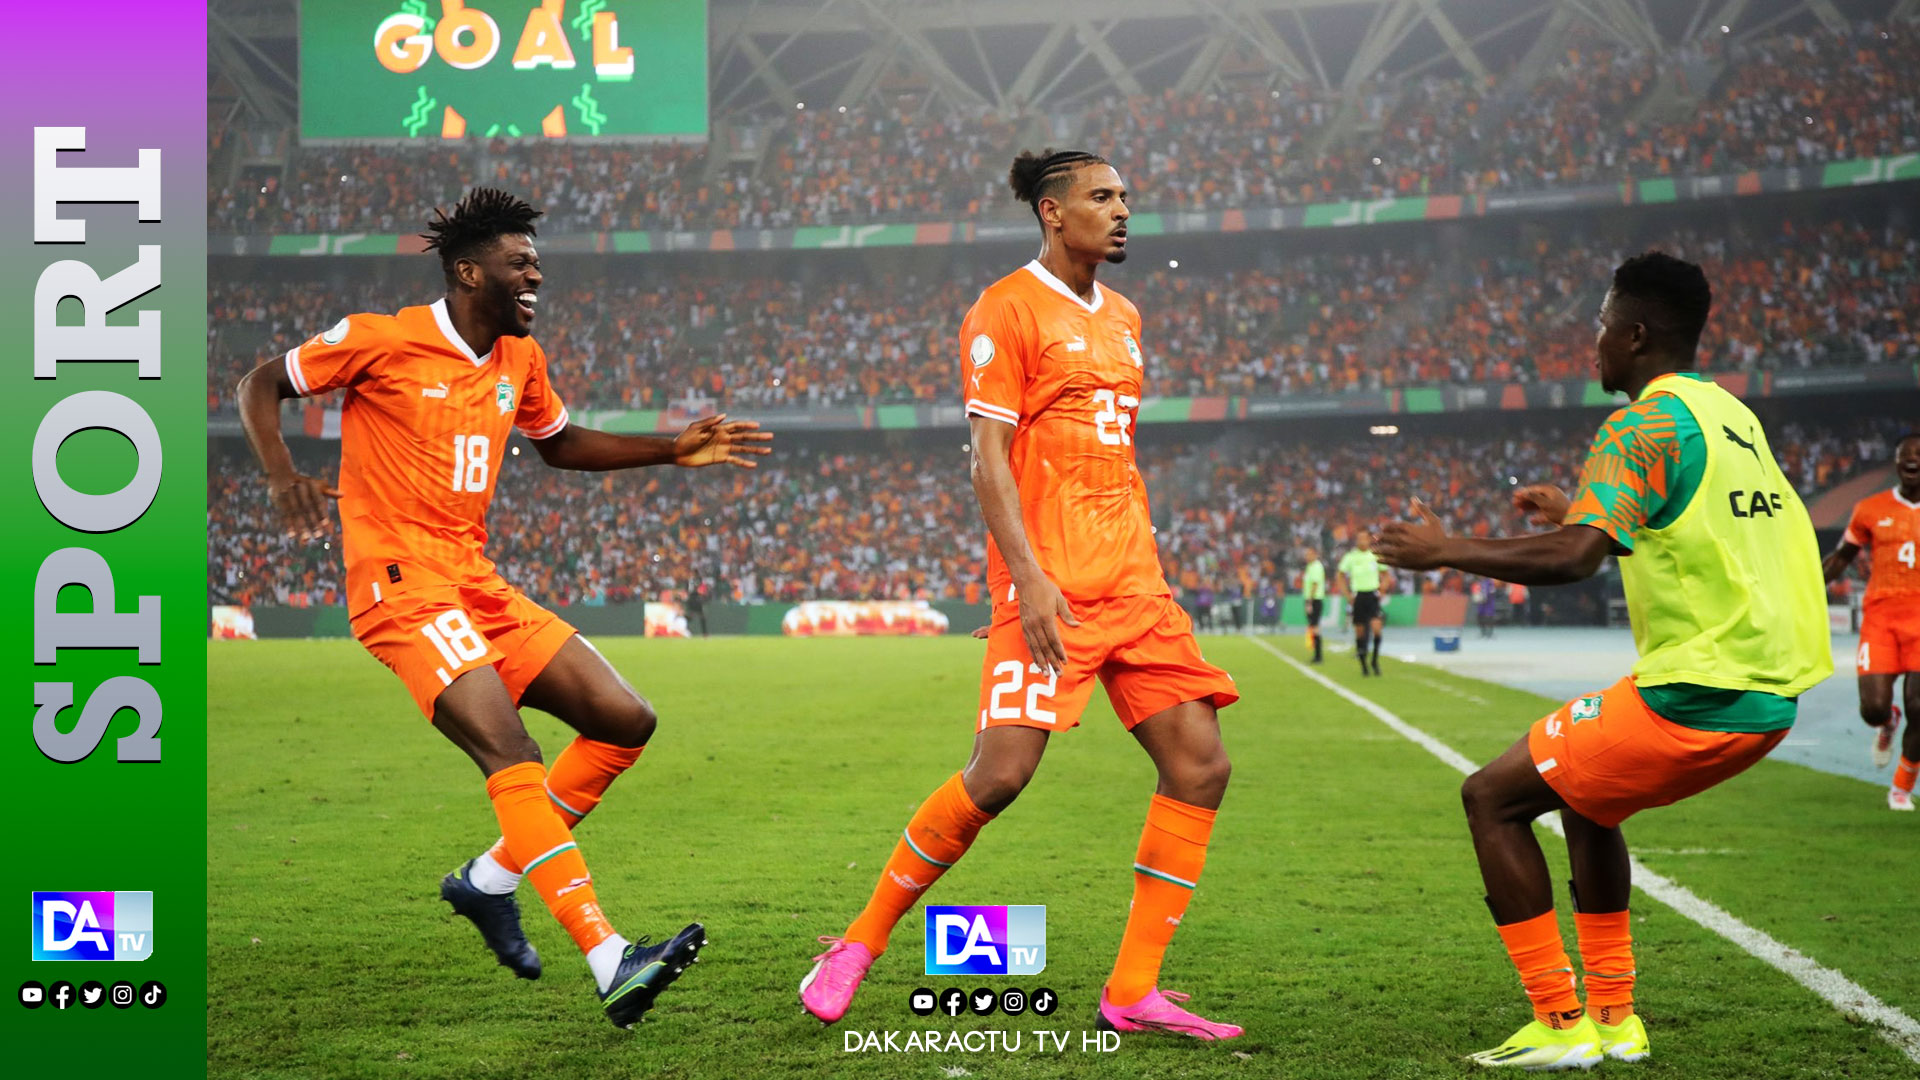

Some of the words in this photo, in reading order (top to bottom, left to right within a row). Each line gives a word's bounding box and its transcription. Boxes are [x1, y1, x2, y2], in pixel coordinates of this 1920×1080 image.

[374, 8, 635, 80] GOAL
[452, 434, 490, 493] 18
[1728, 490, 1783, 518] CAF
[1897, 541, 1916, 569] 4
[420, 609, 488, 671] 18
[1857, 642, 1871, 671] 4
[989, 659, 1058, 724] 22
